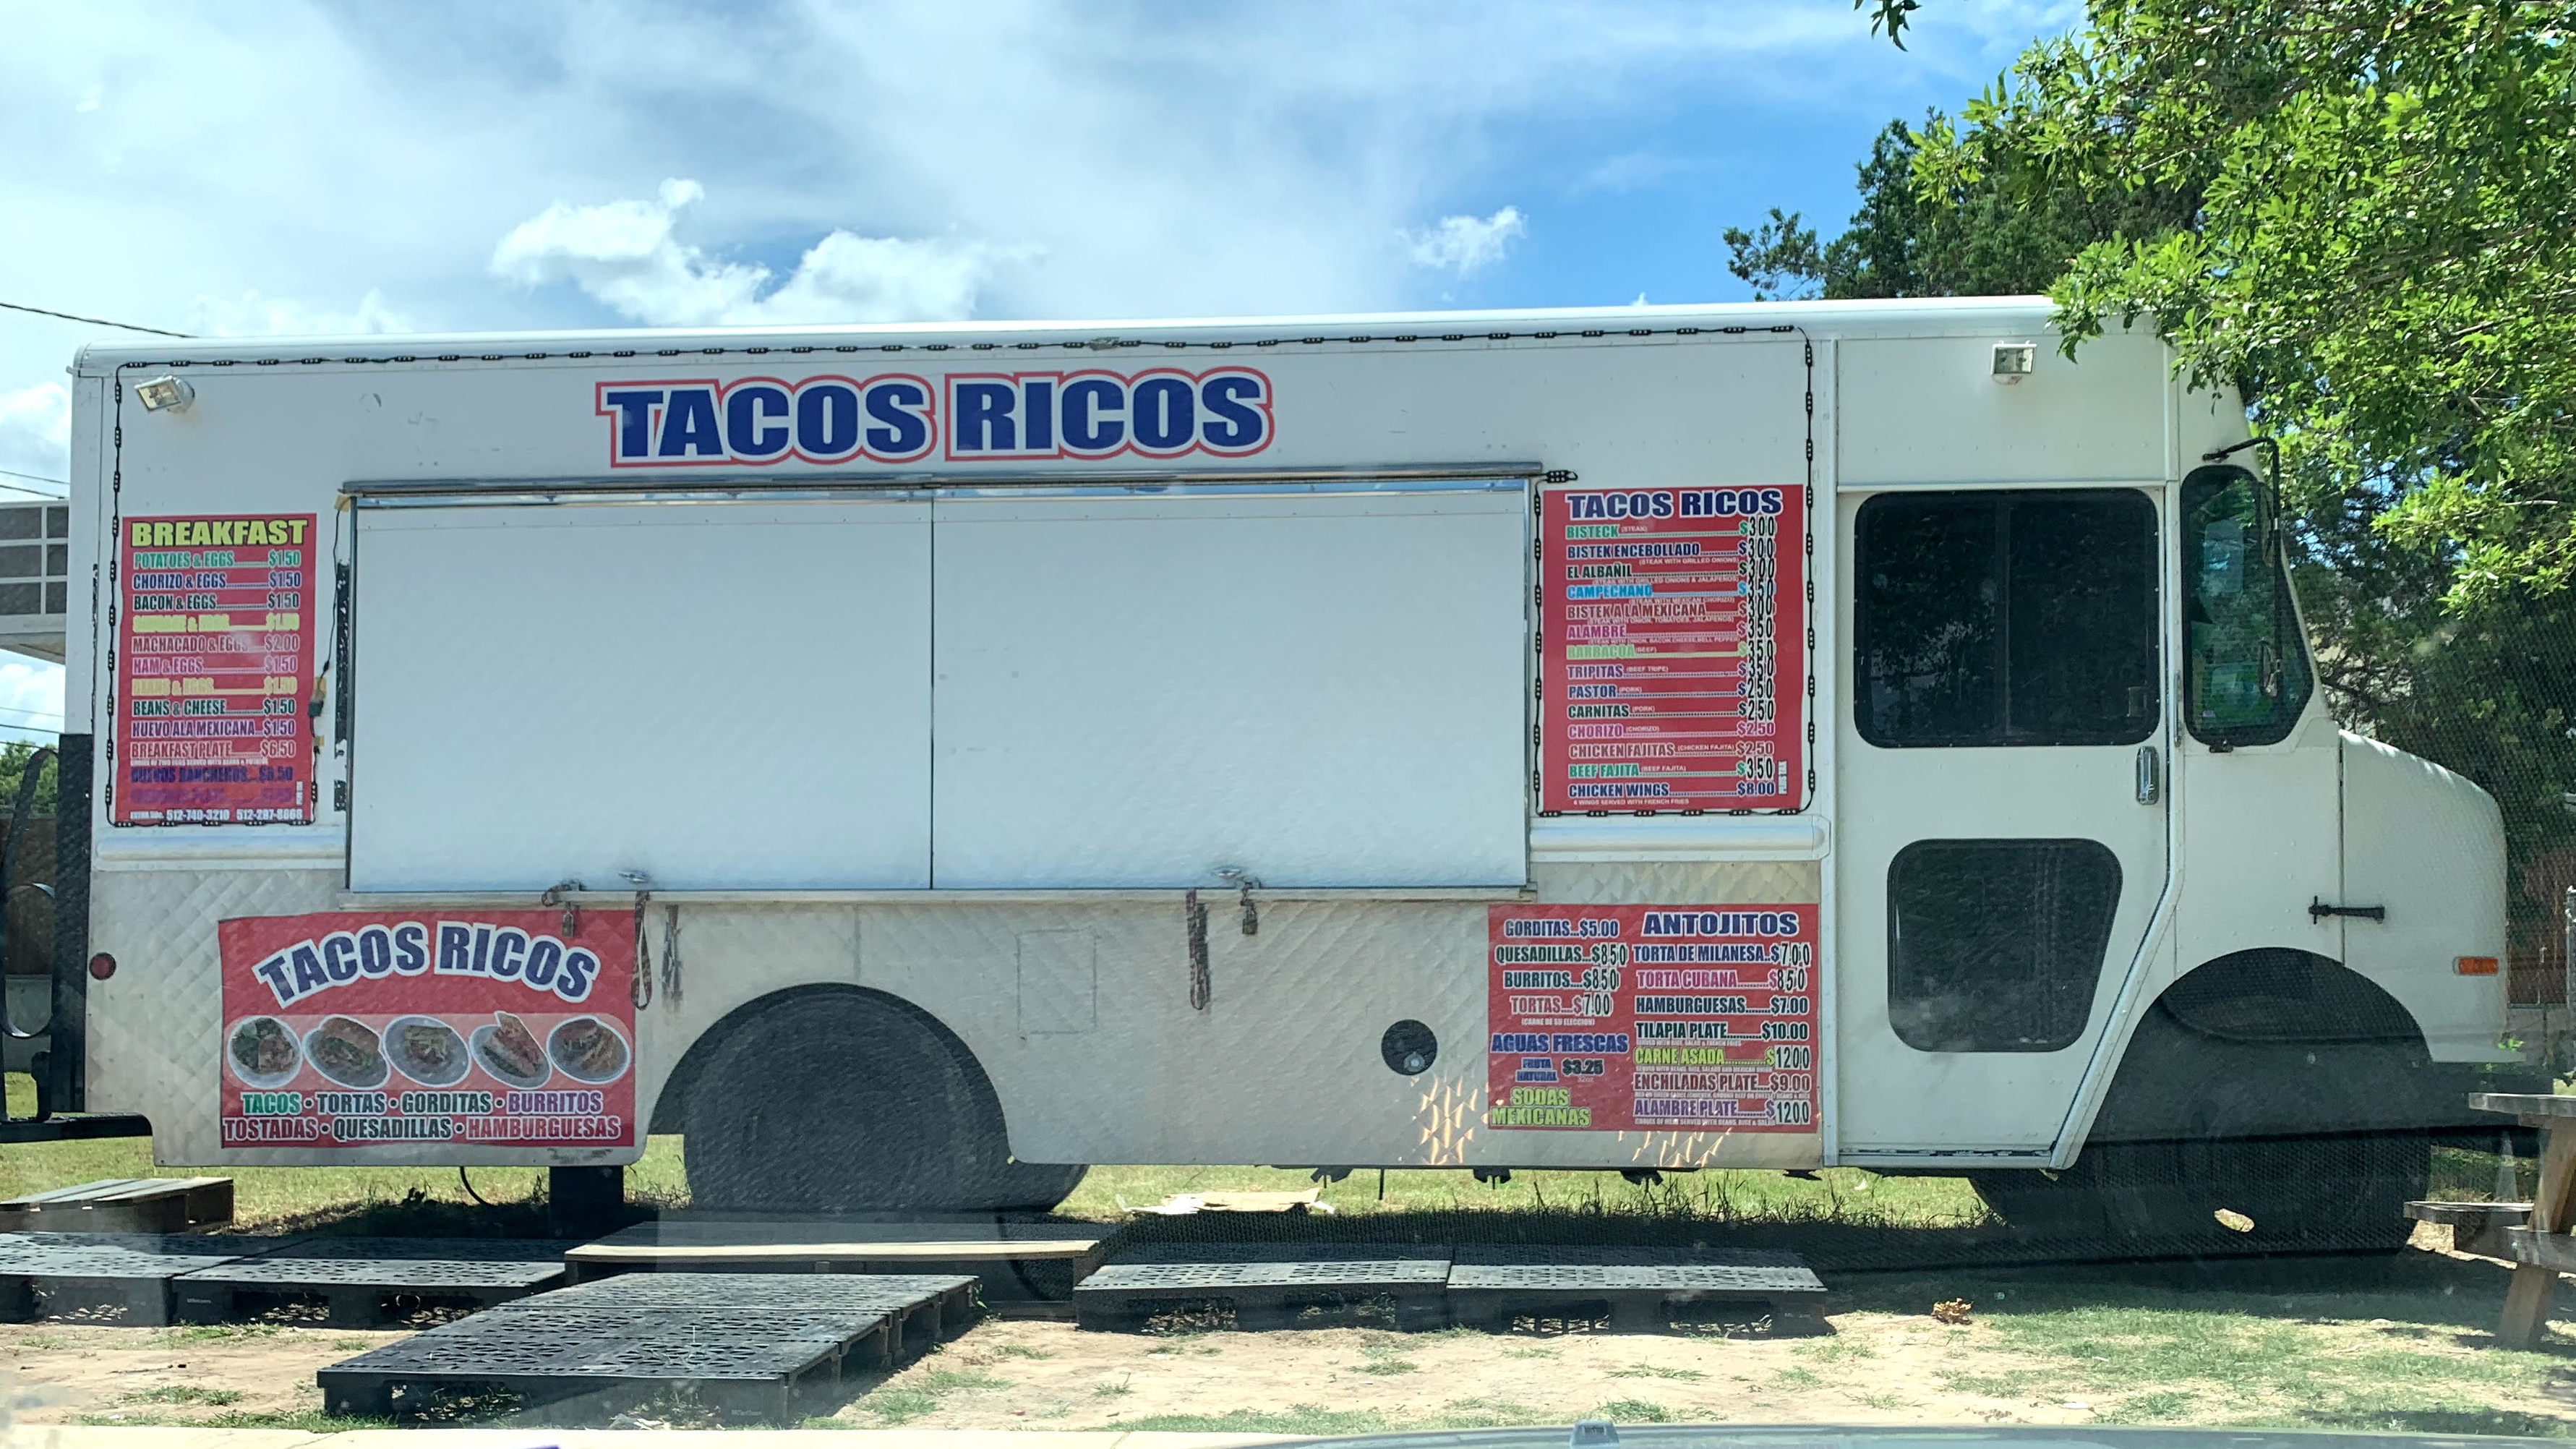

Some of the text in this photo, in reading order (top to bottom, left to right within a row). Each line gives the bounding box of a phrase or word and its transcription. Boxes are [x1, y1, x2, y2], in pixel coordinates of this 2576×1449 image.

[606, 376, 1265, 457] TACOS RICOS
[1566, 490, 1782, 518] TACOS RICOS
[131, 519, 307, 547] BREAKFAST
[1567, 525, 1619, 539] BISTECK
[134, 552, 190, 568] POTATOES
[192, 554, 202, 568] &
[203, 552, 234, 568] EGGS
[1567, 545, 1611, 559] BISTEK
[1614, 543, 1700, 557] ENCEBOLLADO
[1567, 566, 1579, 578] EL
[1582, 562, 1632, 578] ALBAÑIL
[133, 573, 182, 589] CHORIZO
[185, 575, 194, 589] &
[196, 573, 226, 588] EGGS
[1567, 585, 1653, 599] CAMPECHANO
[133, 594, 172, 610] BACON
[176, 597, 184, 610] &
[186, 594, 217, 610] EGGS
[1567, 604, 1612, 620] BISTEK
[1613, 605, 1622, 619] A
[1624, 605, 1640, 618] LA
[1642, 604, 1706, 617] MEXICANA
[1567, 625, 1626, 638] ALAMBRE
[132, 636, 205, 653] MACHACADO
[207, 638, 217, 652] &
[219, 636, 249, 651] EGGS
[1567, 645, 1635, 659] BARBACOA
[132, 657, 161, 674] HAM
[162, 659, 172, 674] &
[174, 657, 203, 673] EGGS
[1567, 665, 1623, 678] TRIPITAS
[1568, 685, 1617, 698] PASTOR
[132, 700, 170, 717] BEANS
[172, 701, 181, 715] &
[184, 699, 226, 716] CHEESE
[1568, 705, 1630, 719] CARNITAS
[132, 720, 171, 738] HUEVO
[197, 719, 255, 737] MEXICANA
[1569, 724, 1623, 738] CHORIZO
[1737, 722, 1776, 737] $2.50
[131, 742, 195, 758] BREAKFAST
[198, 741, 232, 757] PLATE
[1570, 744, 1625, 758] CHICKEN
[1627, 743, 1675, 758] FAJITAS
[1737, 741, 1774, 756] $2.50
[1569, 764, 1597, 778] BEEF
[1600, 764, 1640, 777] FAJITA
[1569, 780, 1776, 798] CHICKEN WINGS $8.00
[1505, 919, 1619, 938] GORDITAS $5.00
[1643, 912, 1798, 936] ANTOJITOS
[1496, 945, 1583, 964] QUESADILLAS
[1633, 944, 1675, 962] TORTA
[1678, 944, 1695, 962] DE
[1698, 944, 1766, 962] MILANESA
[254, 923, 596, 1004] TACOS RICOS
[1504, 970, 1570, 988] BURRITOS
[1638, 970, 1679, 988] TORTA
[1682, 970, 1737, 988] CUBANA
[1510, 996, 1561, 1014] TORTAS
[1635, 996, 1809, 1014] HAMBURGUESAS $7.00
[1635, 1022, 1809, 1040] TILAPIA PLATE $10.00
[1491, 1033, 1629, 1053] AGUAS FRESCAS
[1635, 1047, 1678, 1065] CARNE
[1680, 1048, 1726, 1065] ASADA
[1516, 1070, 1558, 1082] NATURAL
[1522, 1058, 1604, 1076] FRUTA $3.25
[1634, 1073, 1810, 1092] ENCHILADAS PLATE $9.00
[241, 1092, 603, 1114] TACOS TORTAS GORDITAS BURRITOS
[1511, 1087, 1570, 1107] SODAS
[1492, 1106, 1591, 1127] MEXICANAS
[1634, 1099, 1697, 1116] ALAMBRE
[1699, 1099, 1737, 1116] PLATE
[224, 1116, 621, 1141] TOSTADAS QUESADILLAS HAMBURGUESAS
